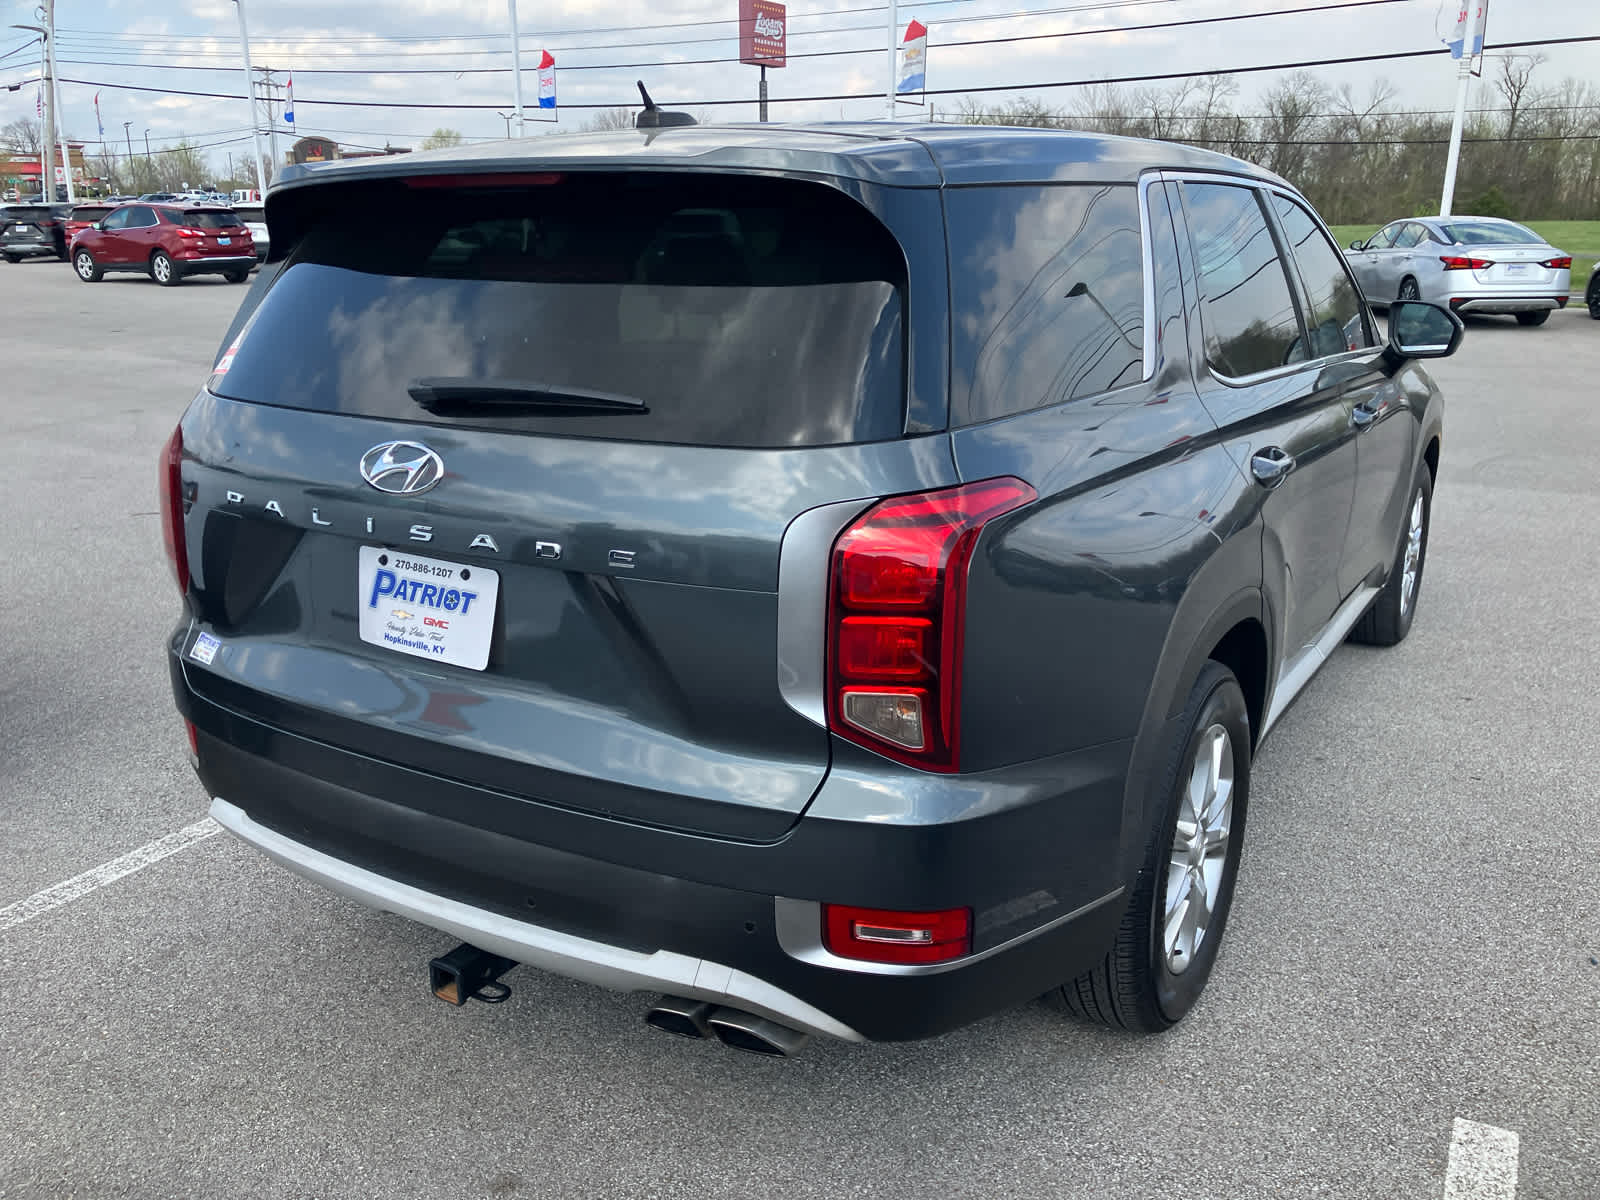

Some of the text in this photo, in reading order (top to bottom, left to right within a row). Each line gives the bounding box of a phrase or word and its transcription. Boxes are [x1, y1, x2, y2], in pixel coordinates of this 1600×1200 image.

[227, 490, 637, 569] PALISADE
[394, 558, 453, 578] 270-886-1207
[368, 568, 477, 614] PATRIOT
[424, 616, 449, 630] GMC
[384, 632, 446, 655] Hopkinsville, KY
